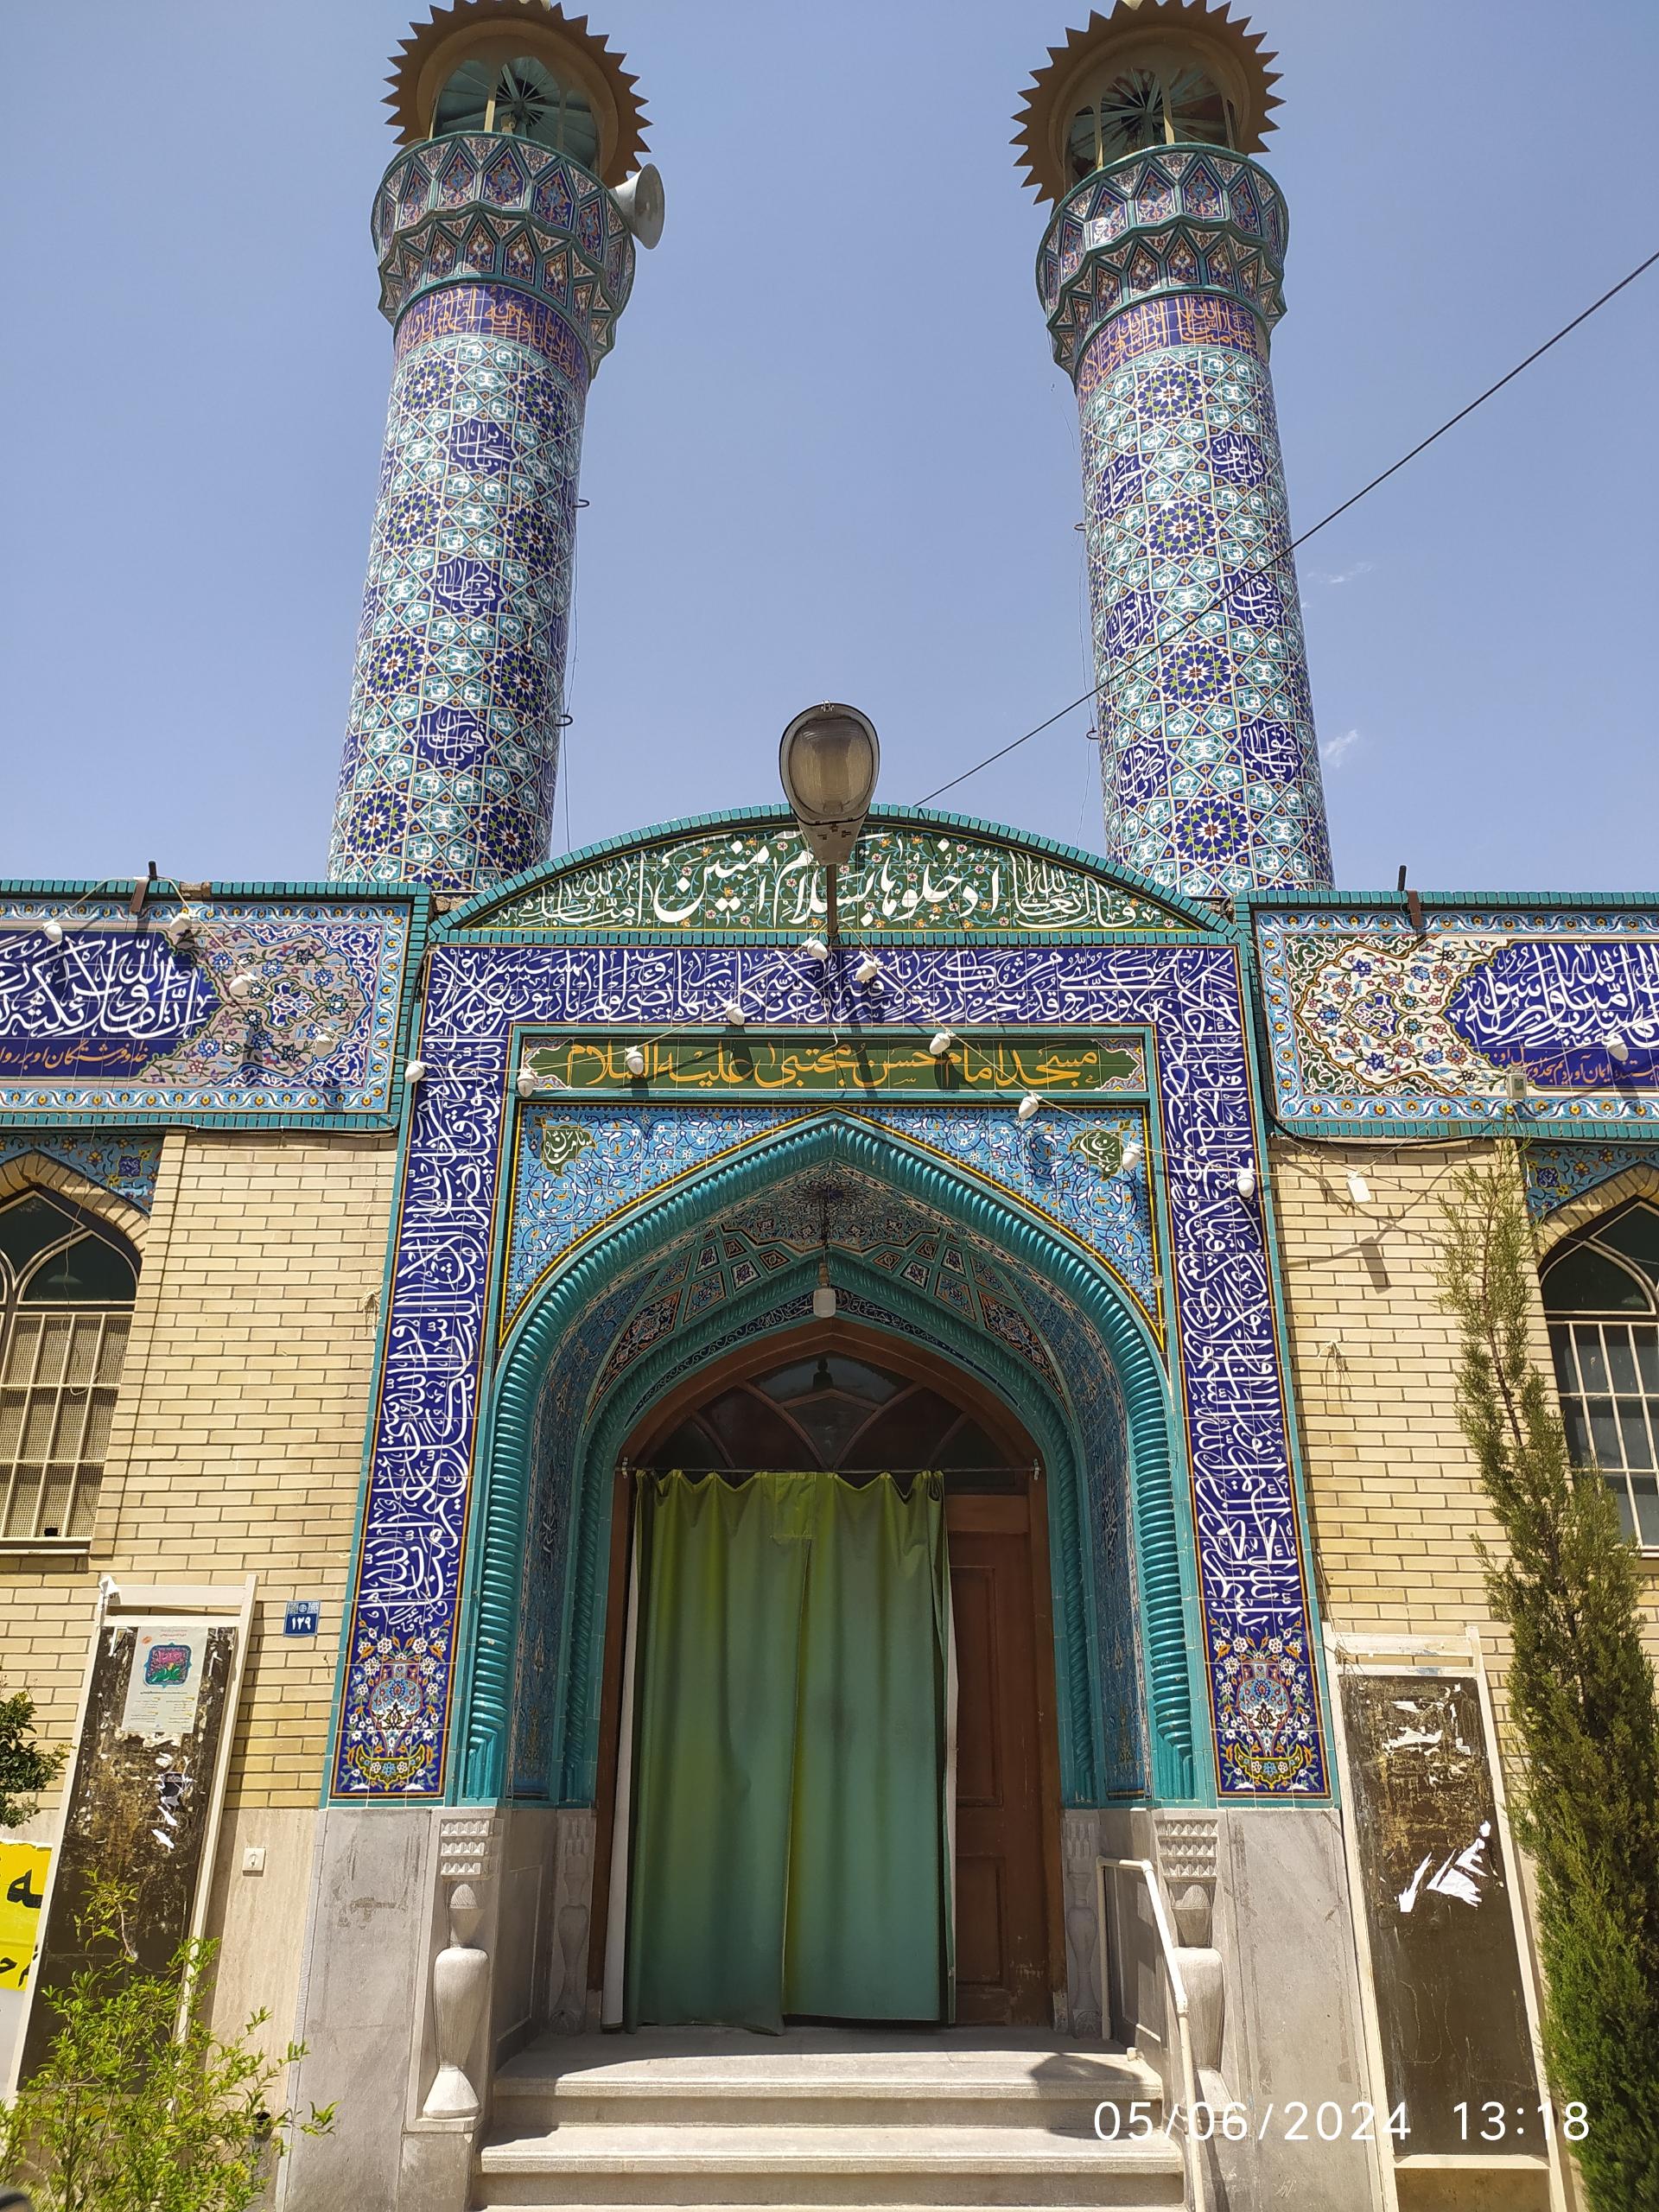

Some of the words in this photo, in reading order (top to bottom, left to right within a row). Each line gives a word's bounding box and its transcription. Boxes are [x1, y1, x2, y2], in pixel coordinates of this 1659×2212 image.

[566, 1039, 659, 1086] السلام
[658, 1039, 753, 1088] علیه
[754, 1042, 861, 1088] مجتبی
[853, 1048, 944, 1088] حسن
[944, 1042, 1004, 1088] امام
[1013, 1044, 1099, 1087] مسجد
